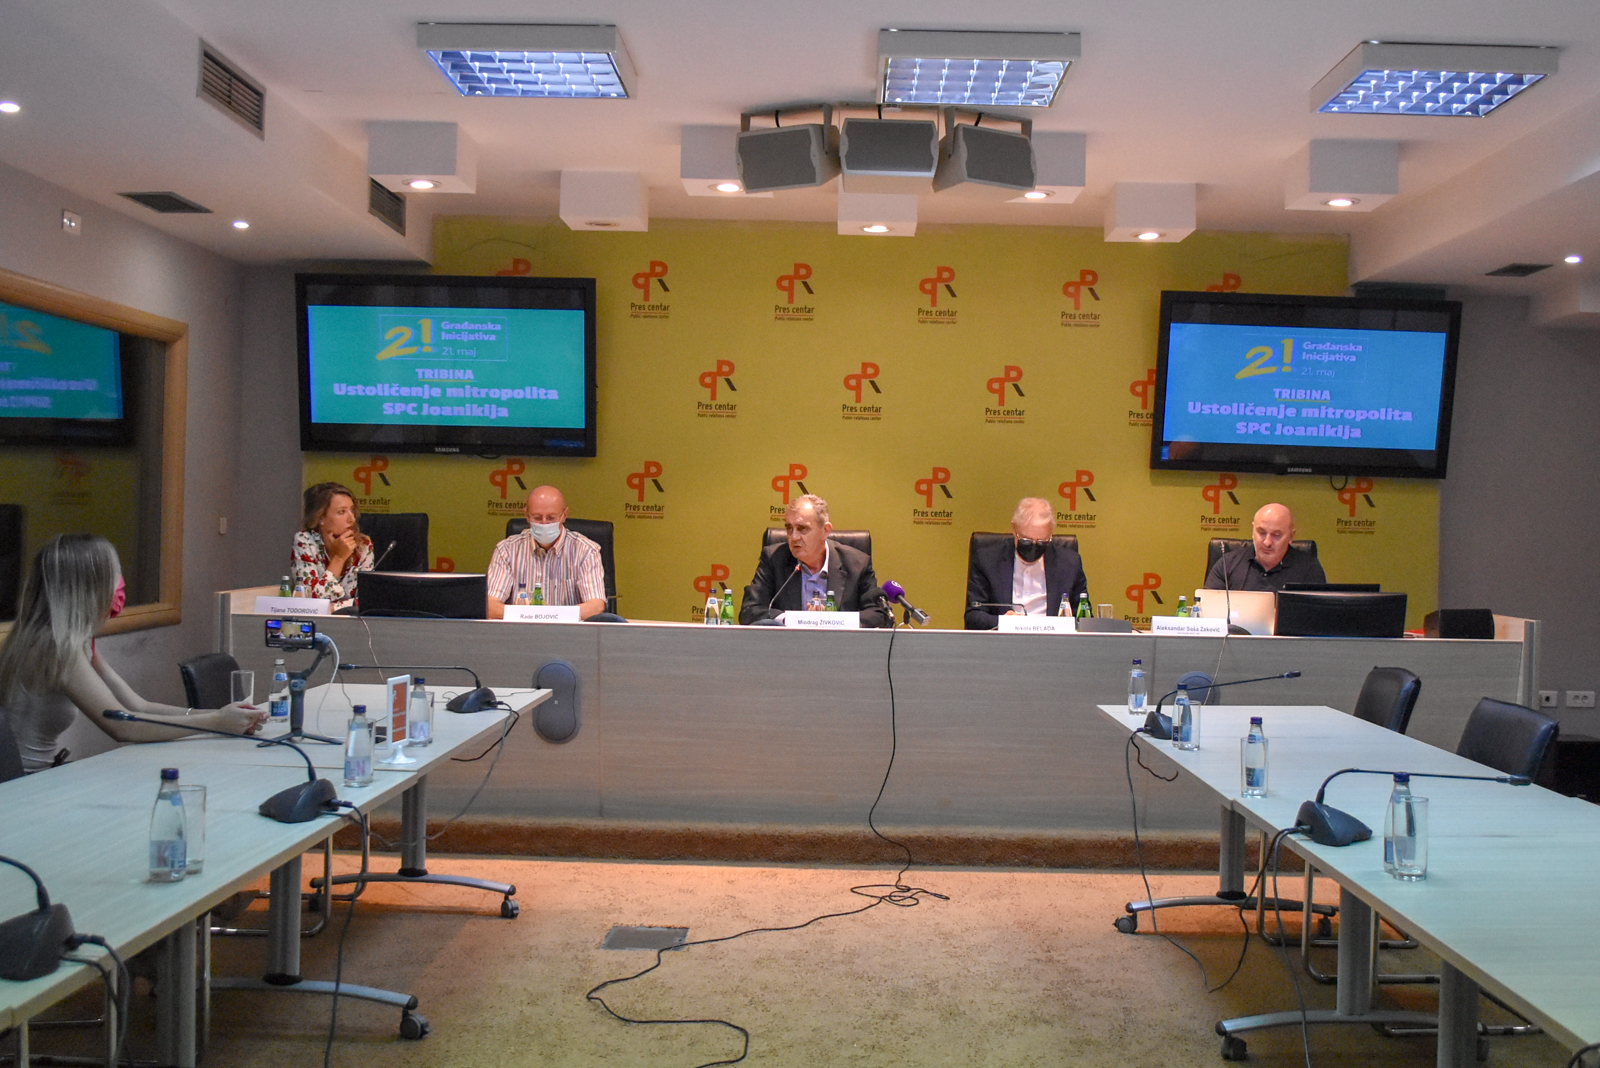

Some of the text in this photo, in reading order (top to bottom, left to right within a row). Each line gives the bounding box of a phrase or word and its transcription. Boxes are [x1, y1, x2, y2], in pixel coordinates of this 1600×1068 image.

[630, 302, 670, 311] Pres centar
[775, 305, 814, 313] Pres centar
[918, 308, 957, 316] Pres centar
[1061, 311, 1076, 319] Pres
[441, 332, 496, 342] Inicijativa
[456, 348, 476, 358] maj
[1302, 352, 1356, 362] Inicijativa
[416, 369, 474, 380] TRIBINA
[1315, 368, 1335, 378] maj
[333, 383, 558, 402] Ustoličenje mitropolita
[1273, 388, 1331, 400] TRIBINA
[697, 402, 737, 410] Pres centar
[842, 404, 857, 412] Pres
[383, 403, 508, 419] SPC Joanikija
[985, 408, 1000, 416] Pres
[1129, 411, 1144, 419] Pres
[1188, 402, 1412, 422] Ustoličenje mitropolita
[1236, 422, 1362, 439] SPC Joanikija
[488, 500, 502, 508] Pres
[625, 503, 664, 512] Pres centar
[770, 506, 785, 514] Pres
[913, 509, 953, 517] Pres centar
[1057, 512, 1072, 520] Pres
[1337, 518, 1375, 527] Pres centar
[1125, 615, 1139, 623] Pres
